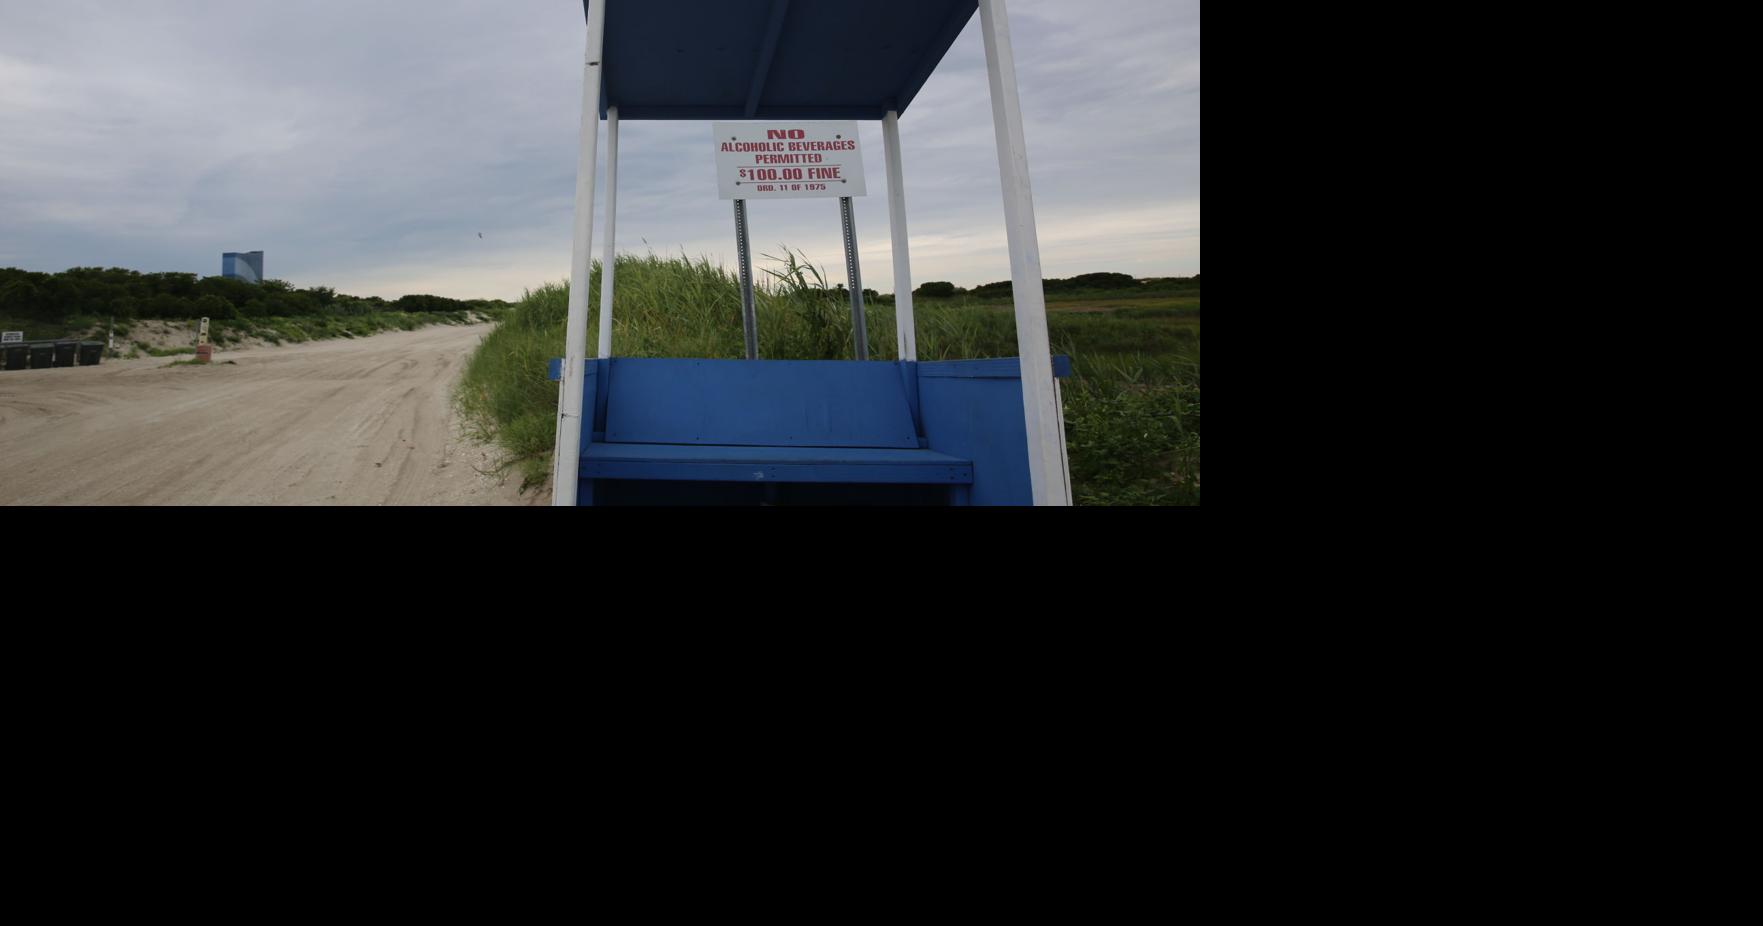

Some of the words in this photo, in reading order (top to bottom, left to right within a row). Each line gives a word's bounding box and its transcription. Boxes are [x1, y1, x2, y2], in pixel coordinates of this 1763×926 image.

[767, 129, 805, 140] NO
[720, 142, 785, 152] ALCOHOLIC
[788, 140, 856, 152] BEVERAGES
[755, 153, 822, 164] PERMITTED
[739, 168, 803, 181] $100.00
[807, 167, 841, 179] FINE
[805, 183, 826, 191] 1975
